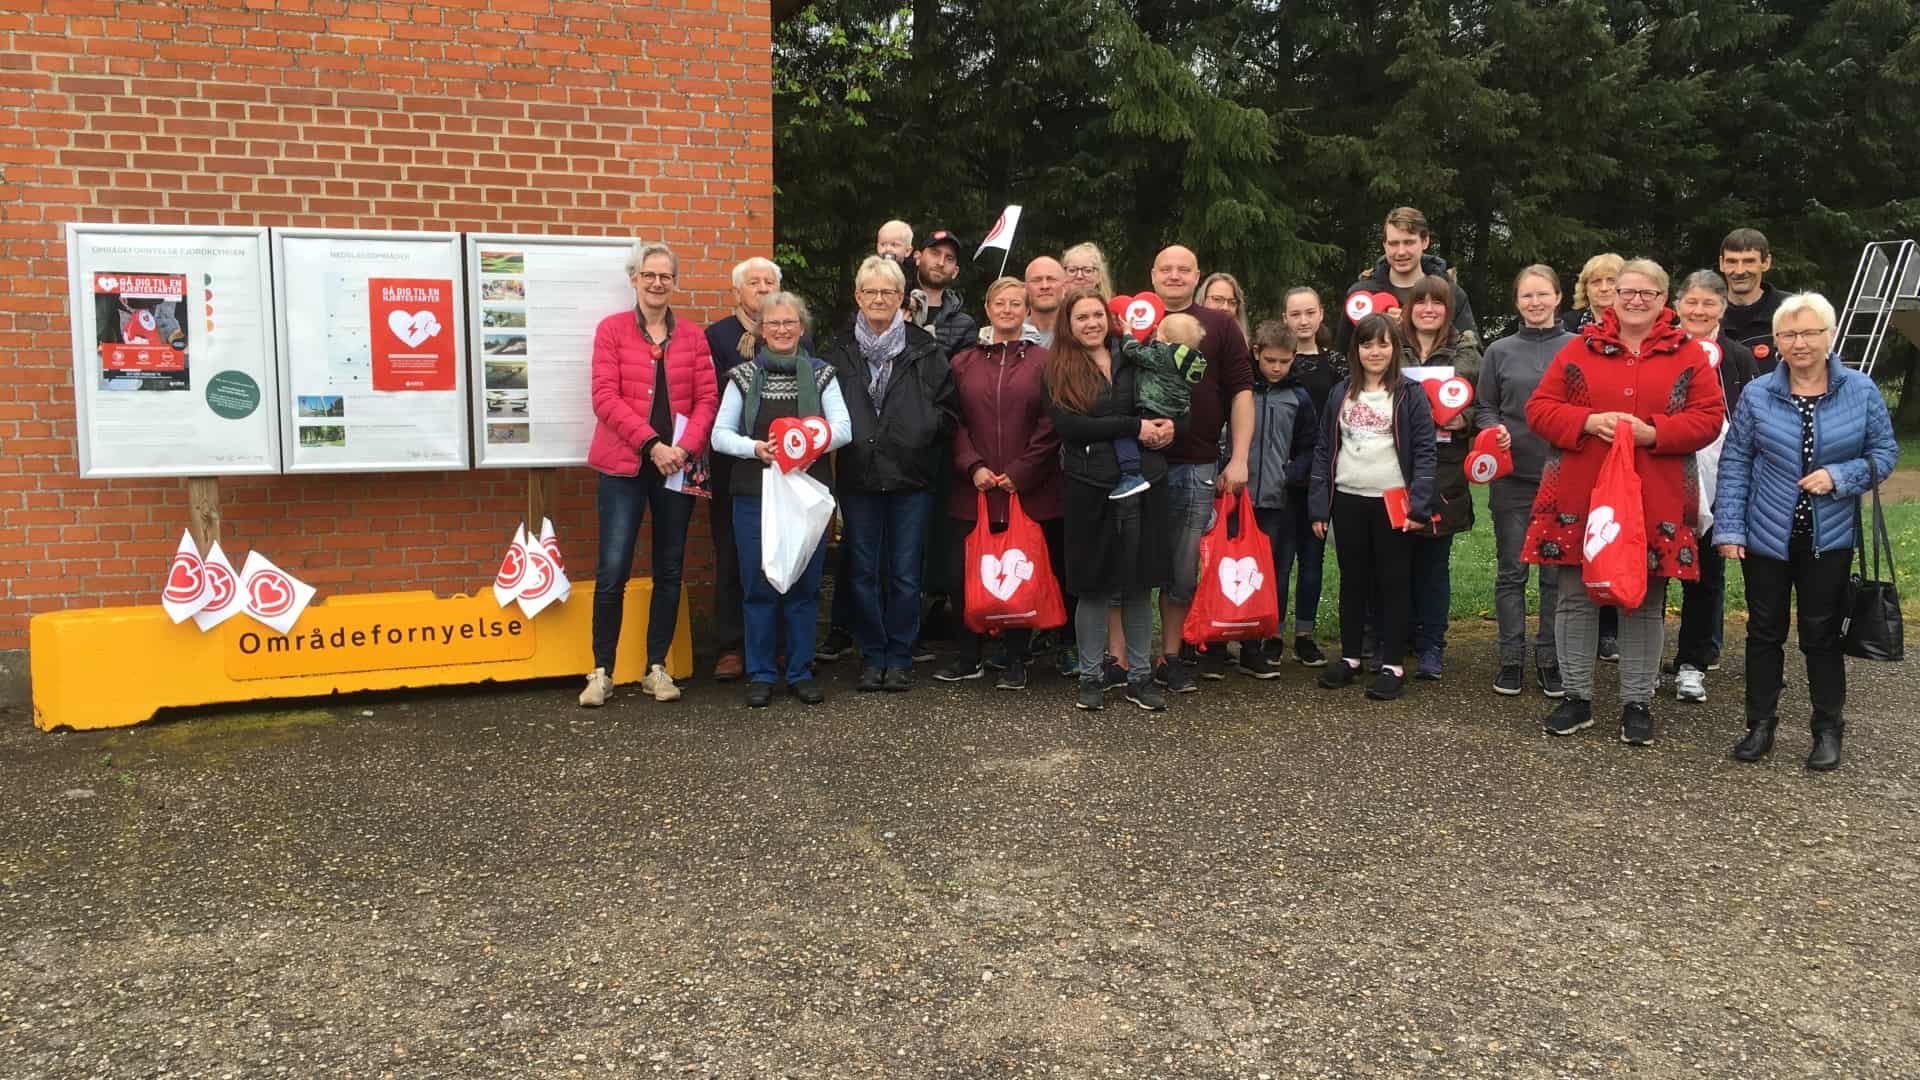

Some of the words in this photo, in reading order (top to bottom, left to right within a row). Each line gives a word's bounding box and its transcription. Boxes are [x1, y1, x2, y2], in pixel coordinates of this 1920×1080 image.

[135, 278, 151, 287] DIG
[397, 287, 412, 296] DIG
[238, 617, 523, 655] Områdefornyelse
